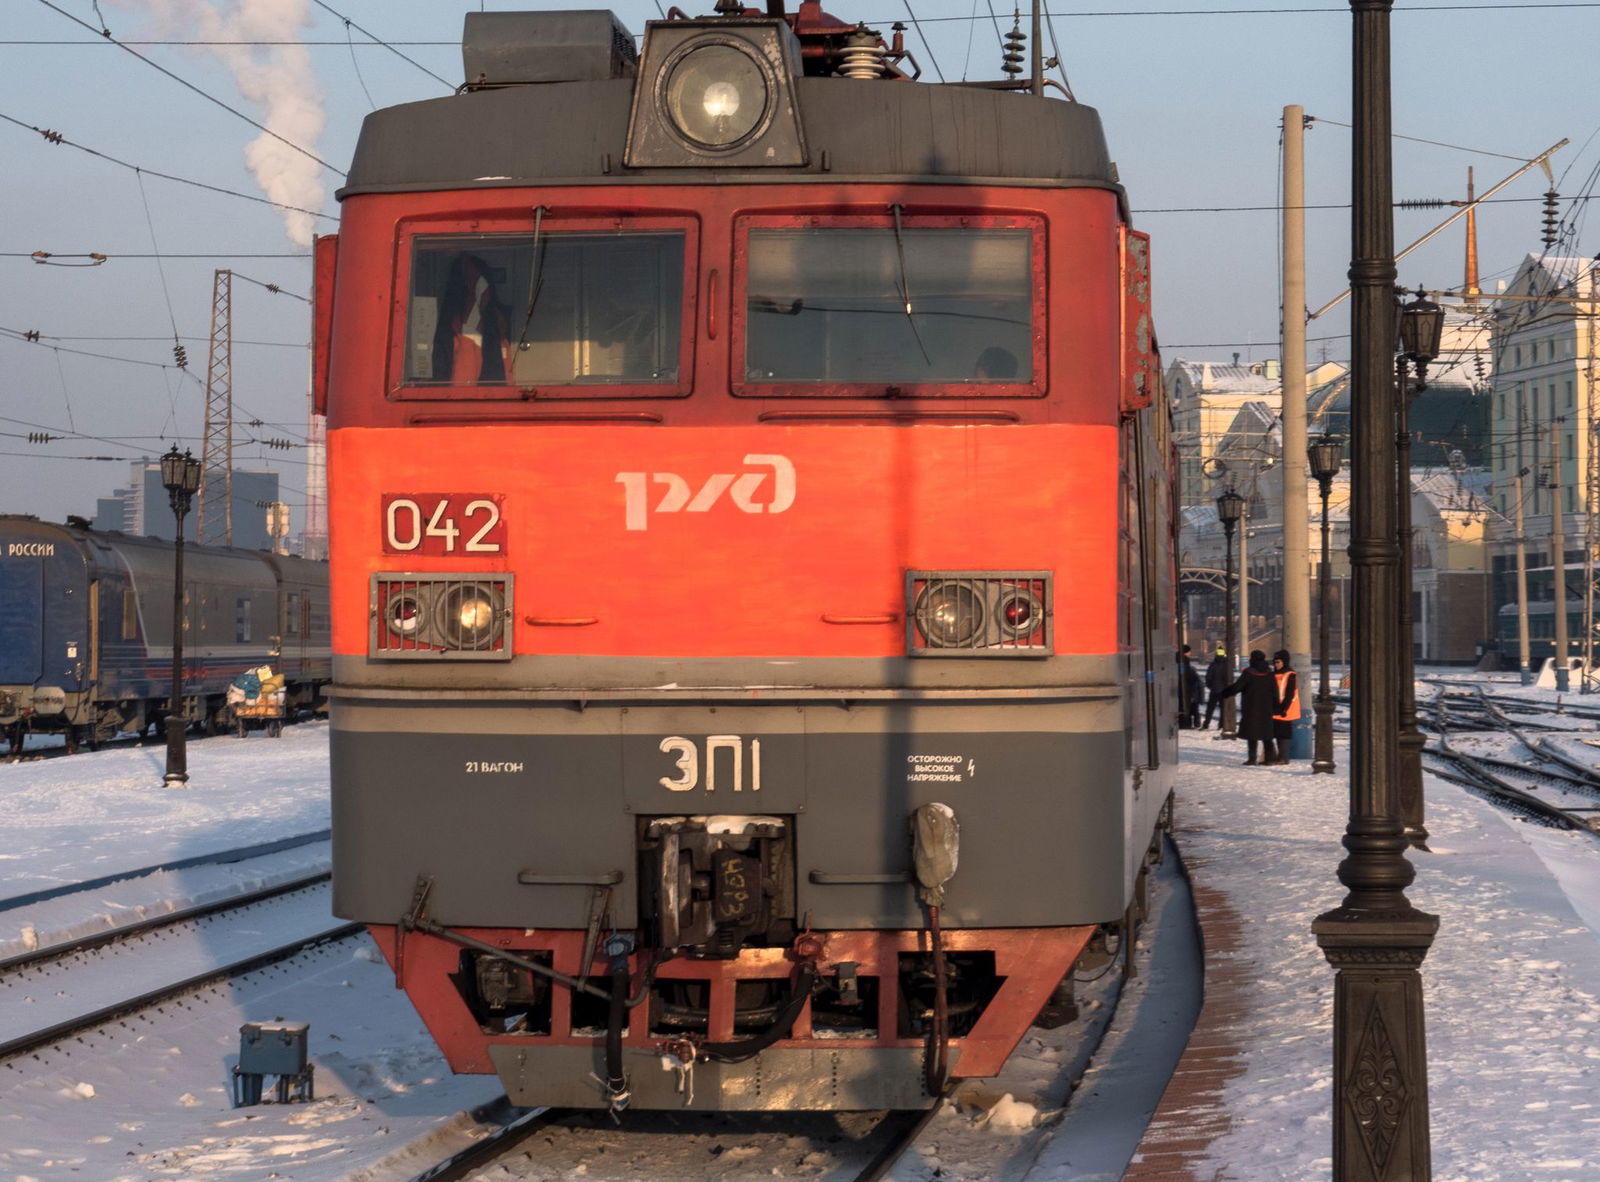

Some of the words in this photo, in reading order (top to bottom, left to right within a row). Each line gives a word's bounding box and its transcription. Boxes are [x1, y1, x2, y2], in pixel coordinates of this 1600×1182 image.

[387, 499, 501, 552] 042
[9, 543, 54, 556] РОССИИ
[907, 755, 963, 763] ОСТОРОЖНО
[465, 761, 478, 772] 21
[481, 761, 523, 772] ВАГОН
[914, 764, 955, 772] ВЫСОКОЕ
[907, 774, 962, 782] НАПРЯЖЕНИЕ
